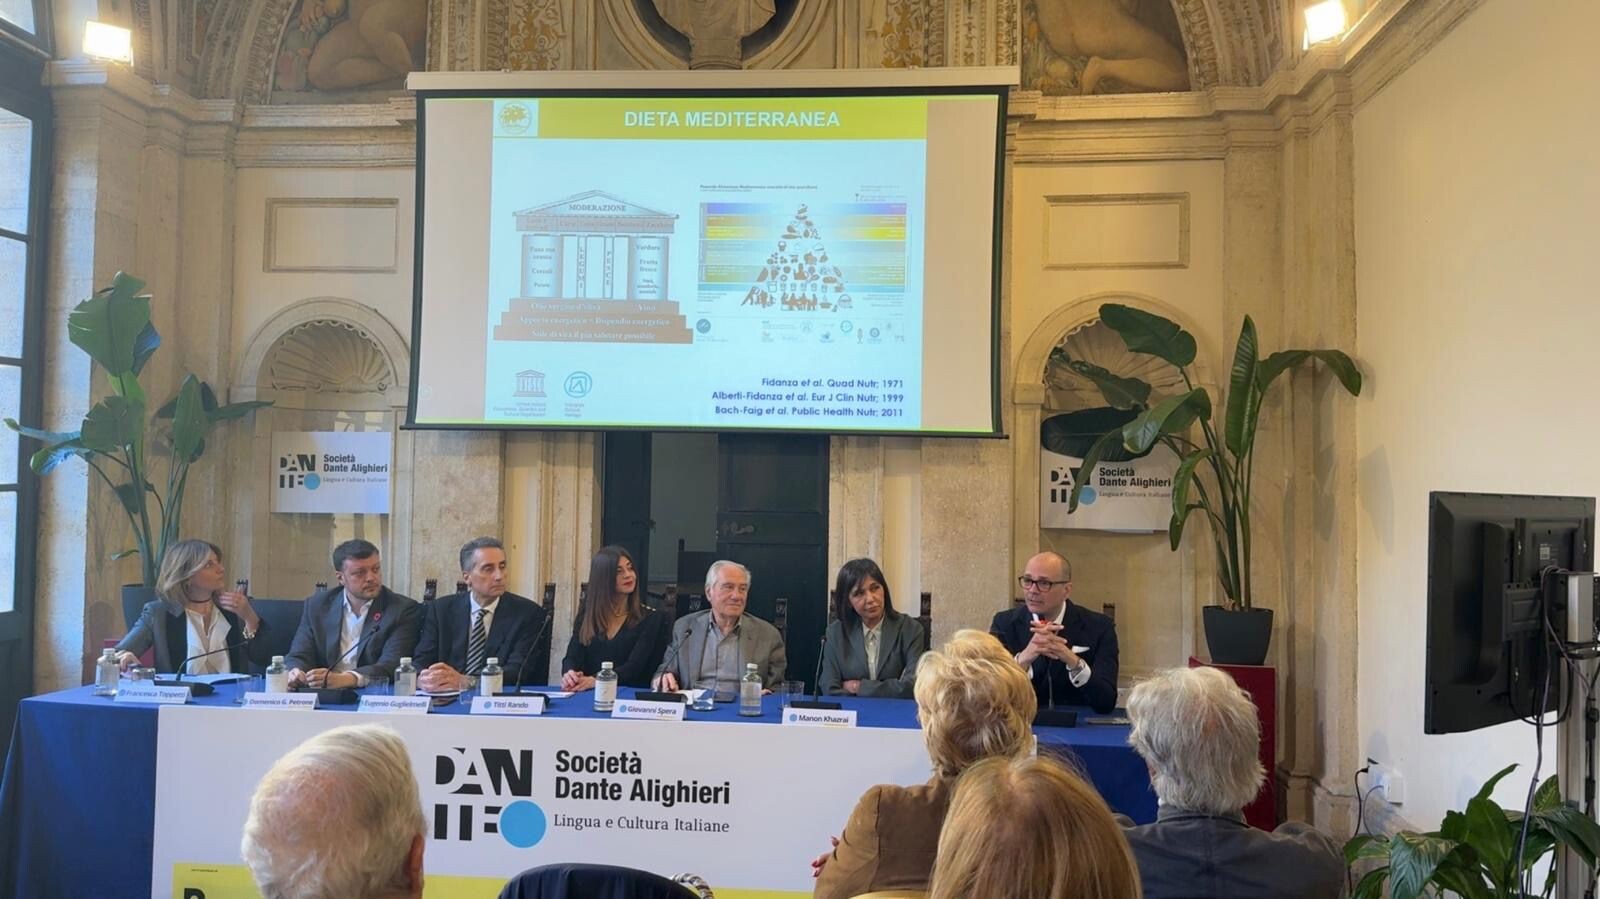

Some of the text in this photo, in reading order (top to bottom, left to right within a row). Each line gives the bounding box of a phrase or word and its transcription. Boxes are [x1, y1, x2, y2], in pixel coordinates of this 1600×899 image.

[624, 110, 841, 127] DIETA MEDITERRANEA
[568, 203, 627, 212] MODERAZIONE
[761, 378, 903, 389] Fidanza et al. Quad Nutr; 1971
[711, 391, 904, 403] Alberti-Fidanza et al. Eur J Clin Nutr; 1999
[715, 405, 903, 418] Bach-Faig et al. Public Health Nutr; 2011
[323, 453, 356, 463] Società
[323, 463, 388, 474] Dante Alighieri
[1099, 467, 1135, 477] Società
[1099, 478, 1171, 488] Dante Alighieri
[126, 690, 159, 698] Francesca
[249, 698, 281, 706] Domenico
[282, 698, 288, 706] G.
[364, 699, 428, 709] Eugenio Guglielmelli
[493, 701, 529, 709] Titti Rando
[628, 705, 678, 716] Giovanni Spera
[799, 714, 850, 724] Manon Khazrai
[555, 750, 643, 775] Società
[435, 747, 534, 797] DAN
[555, 776, 731, 808] Dante Alighieri
[553, 813, 730, 833] Lingua e Cultura Italiane
